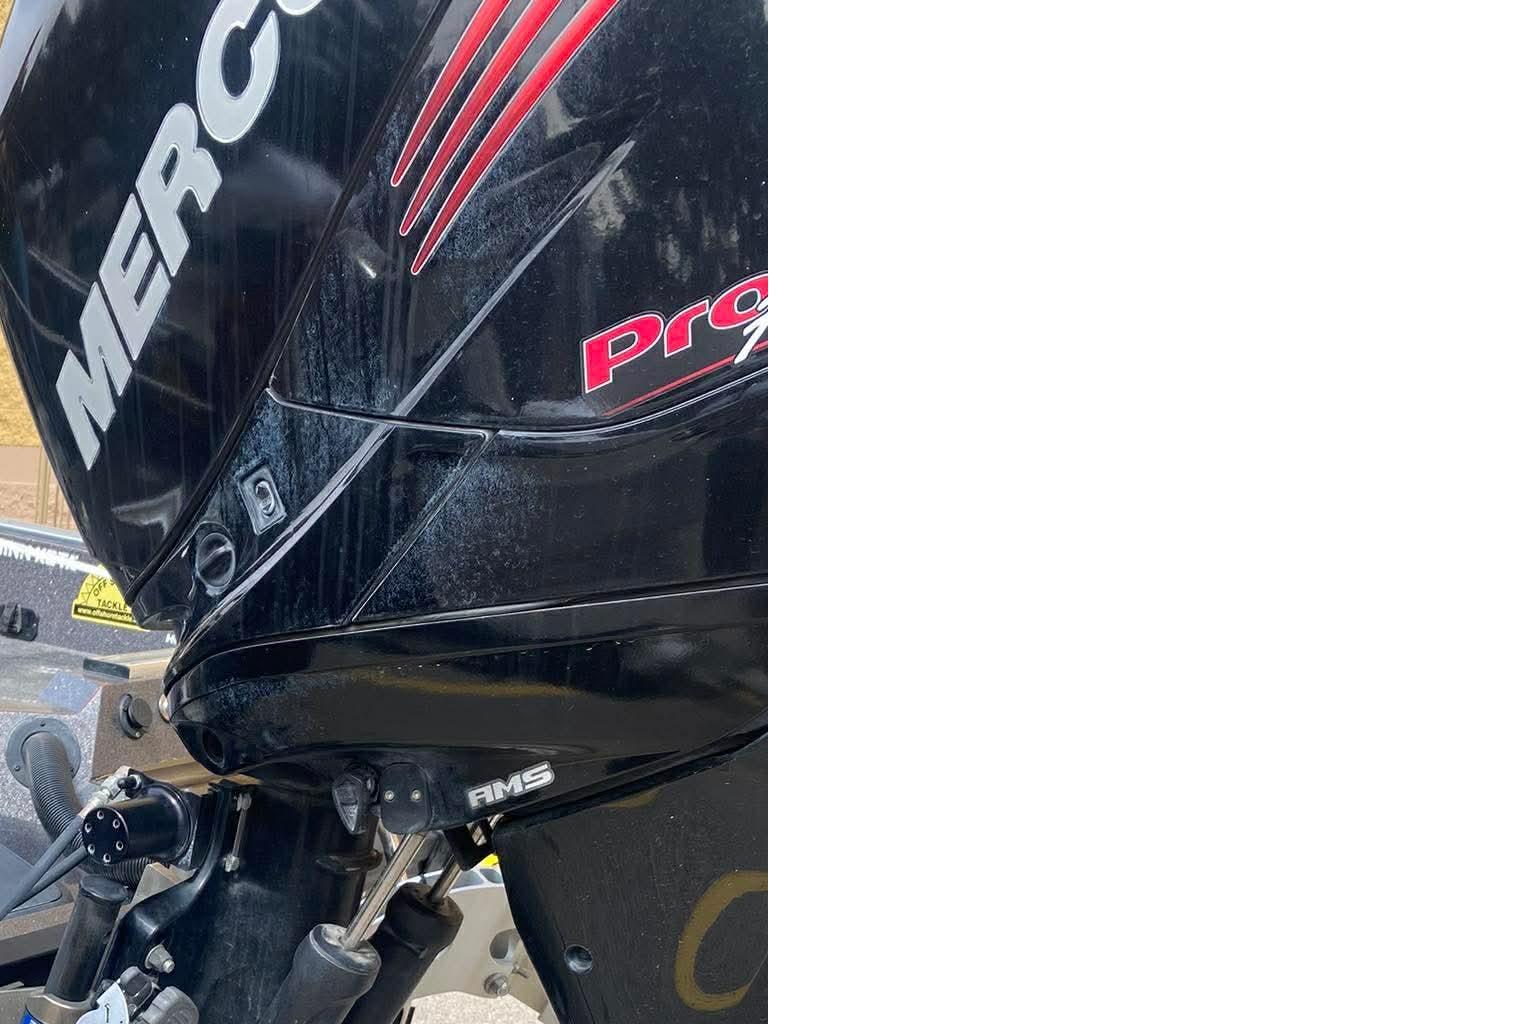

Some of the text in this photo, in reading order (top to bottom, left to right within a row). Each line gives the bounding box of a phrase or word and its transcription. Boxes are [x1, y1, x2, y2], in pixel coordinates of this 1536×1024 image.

[56, 0, 322, 471] MERC
[582, 273, 768, 394] Pro
[467, 762, 555, 809] AMS
